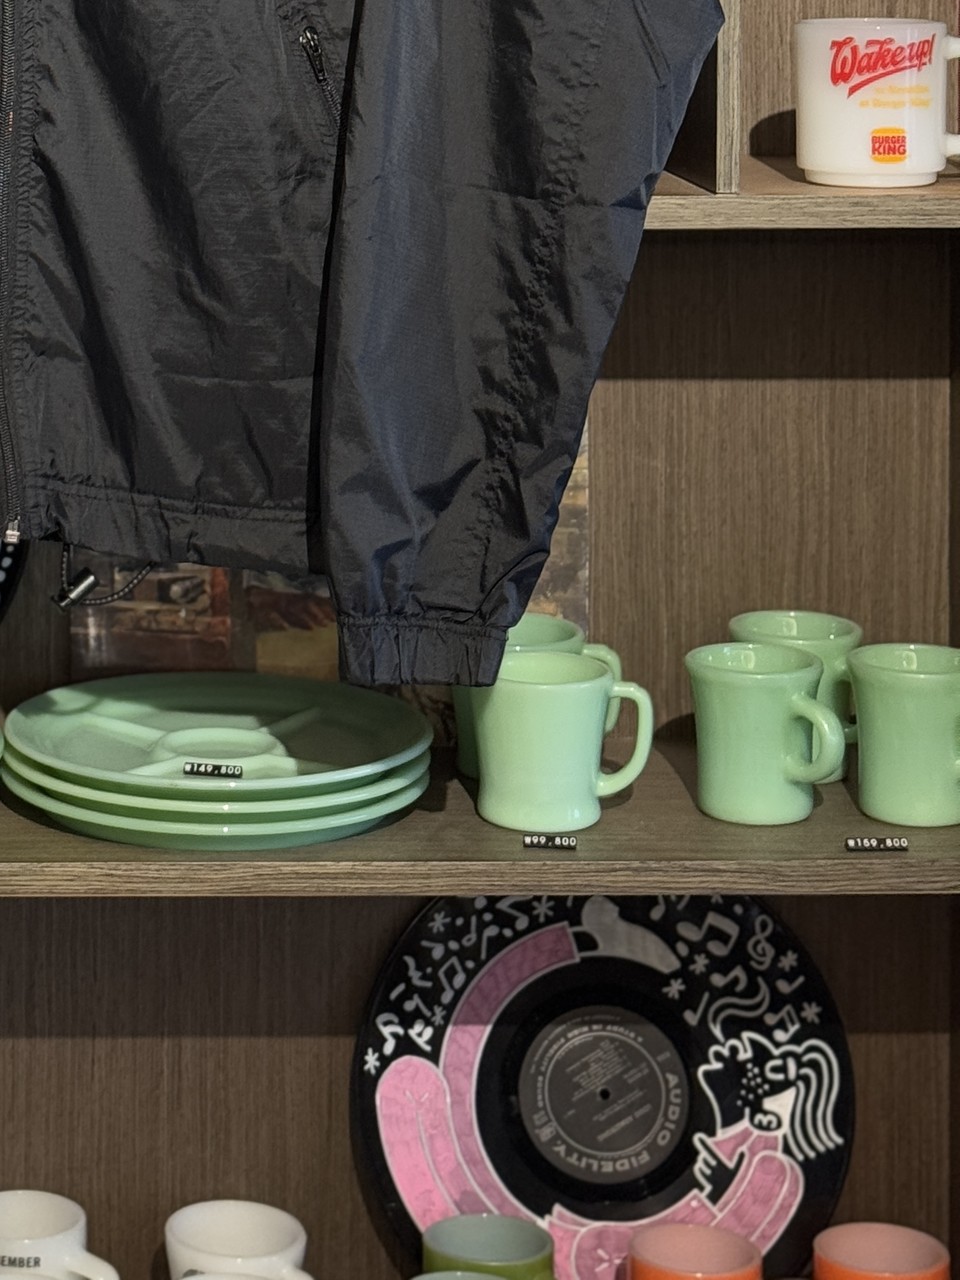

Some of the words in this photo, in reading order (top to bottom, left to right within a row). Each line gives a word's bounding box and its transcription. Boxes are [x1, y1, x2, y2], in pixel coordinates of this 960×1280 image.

[830, 36, 906, 87] Wake
[871, 135, 907, 144] BURGER
[871, 144, 907, 155] KING
[656, 1071, 683, 1147] AUDIO
